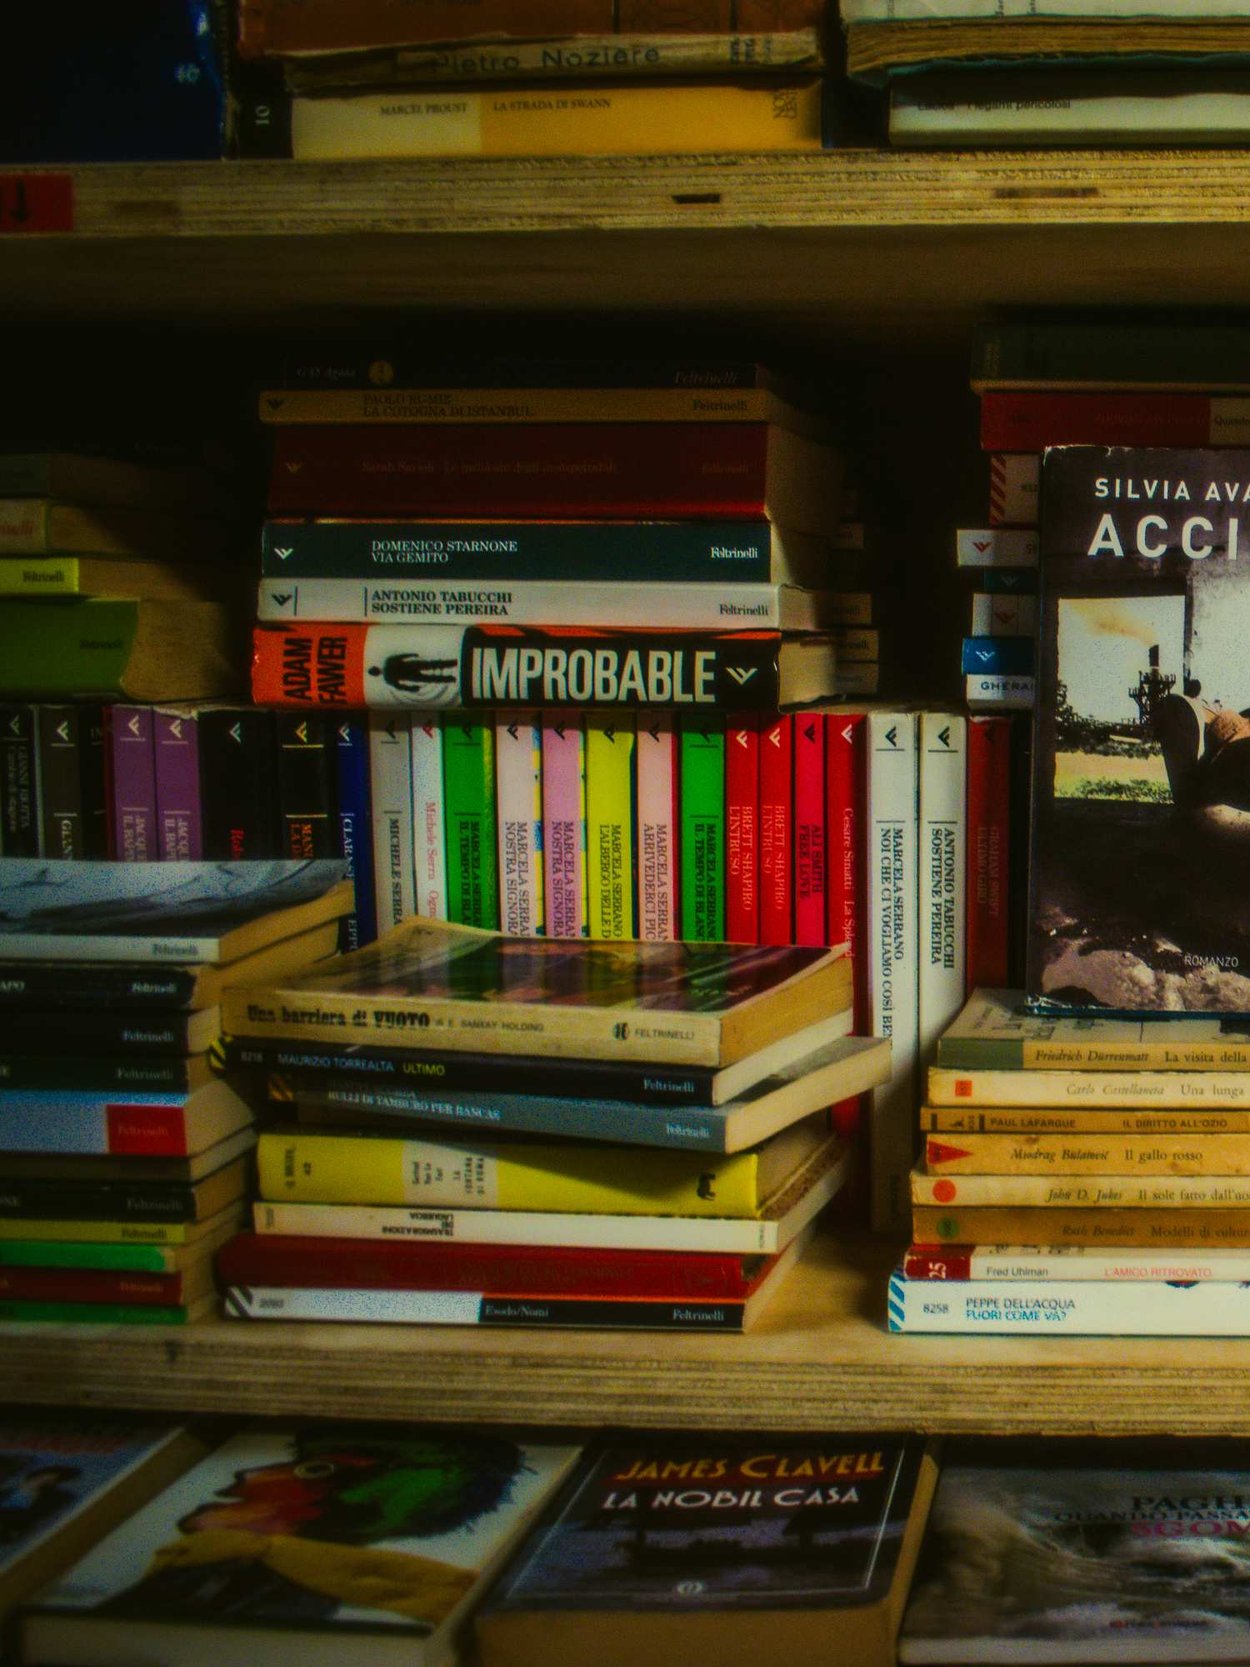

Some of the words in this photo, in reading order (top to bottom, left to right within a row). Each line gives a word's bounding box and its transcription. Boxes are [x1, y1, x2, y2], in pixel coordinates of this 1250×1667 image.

[380, 104, 422, 116] MARCEL
[425, 102, 467, 114] PROUST
[493, 101, 508, 111] LA
[510, 100, 553, 111] STRADA
[555, 100, 567, 110] DI
[570, 98, 611, 110] SWANN
[1094, 477, 1191, 501] SILVIA
[371, 540, 443, 553] DOMENICO
[446, 540, 518, 553] STARNONE
[371, 552, 393, 563] VIA
[397, 552, 450, 563] GEMITO
[709, 545, 759, 559] Feltrinelli
[371, 590, 436, 603] ANTONIO
[439, 591, 513, 604] TABUCCHI
[371, 602, 440, 616] SOSTIENE
[442, 603, 509, 616] PEREIRA
[718, 603, 769, 616] Feltrinelli
[282, 636, 313, 703] ADAM
[316, 636, 349, 704] FAWER
[471, 647, 718, 703] IMPROBABLE
[426, 802, 437, 846] Michele
[742, 805, 753, 849] BRETT
[775, 805, 786, 848] BRETT
[843, 807, 854, 847] Cesare
[390, 818, 402, 879] MICHELE
[505, 822, 517, 875] NOSTRA
[552, 822, 564, 875] NOSTRA
[612, 824, 622, 880] MARCELA
[881, 828, 891, 852] NOI
[427, 848, 438, 880] Serra
[517, 822, 529, 886] MARCELA
[564, 822, 576, 886] MARCELA
[657, 824, 668, 887] MARCELA
[893, 828, 903, 894] MARCELA
[931, 828, 943, 899] SOSTIENE
[943, 828, 955, 893] ANTONIO
[644, 824, 656, 914] ARRIVEDERCI
[775, 851, 786, 910] SHAPIRO
[881, 856, 891, 885] CHE
[742, 852, 753, 911] SHAPIRO
[601, 889, 611, 926] DELLE
[612, 883, 623, 938] SERRANO
[893, 896, 904, 960] SERRANO
[931, 902, 943, 964] PEREIRA
[943, 898, 955, 969] TABUCCHI
[152, 944, 198, 957] Feltrinelli
[881, 906, 892, 977] VOGLIAMO
[1184, 955, 1239, 968] ROMANZO
[132, 982, 176, 993] Feltrinelli
[281, 1007, 346, 1026] barriera
[121, 1029, 175, 1041] Feltrinelli
[634, 1028, 695, 1040] FELTRINELLI
[277, 1054, 331, 1068] MAURIZIO
[334, 1057, 395, 1073] TORREALTA
[402, 1063, 445, 1076] ULTIMO
[1035, 1050, 1082, 1062] Friedrich
[1164, 1051, 1179, 1062] La
[1184, 1051, 1214, 1063] visita
[1219, 1051, 1247, 1063] della
[116, 1066, 175, 1080] Feltrinelli
[643, 1078, 695, 1093] Feltrinelli
[1066, 1083, 1095, 1095] Carlo
[1101, 1083, 1165, 1096] Castellaneta
[1179, 1084, 1205, 1096] Una
[1212, 1084, 1245, 1099] lunga
[665, 1122, 710, 1138] Feltrinelli
[990, 1118, 1017, 1128] PAUL
[1020, 1118, 1076, 1129] LAFARGUE
[1136, 1119, 1177, 1129] DIRITTO
[1138, 1149, 1167, 1164] gallo
[1172, 1151, 1204, 1161] rosso
[1152, 1190, 1175, 1201] sole
[1180, 1190, 1206, 1201] fatto
[121, 1227, 167, 1240] Feltrinelli
[1151, 1226, 1195, 1238] Modelli
[986, 1267, 1009, 1277] Fred
[1011, 1267, 1049, 1277] Uhlman
[672, 1308, 724, 1321] Feltrinelli
[923, 1303, 949, 1314] 8258
[966, 1299, 999, 1309] PEPPE
[966, 1310, 1001, 1321] FUORI
[1005, 1310, 1041, 1321] COME
[614, 1457, 728, 1481] JAMES
[739, 1450, 886, 1477] CLAVELL
[602, 1491, 639, 1510] LA
[650, 1489, 763, 1509] NOBIL
[773, 1486, 860, 1507] CASA
